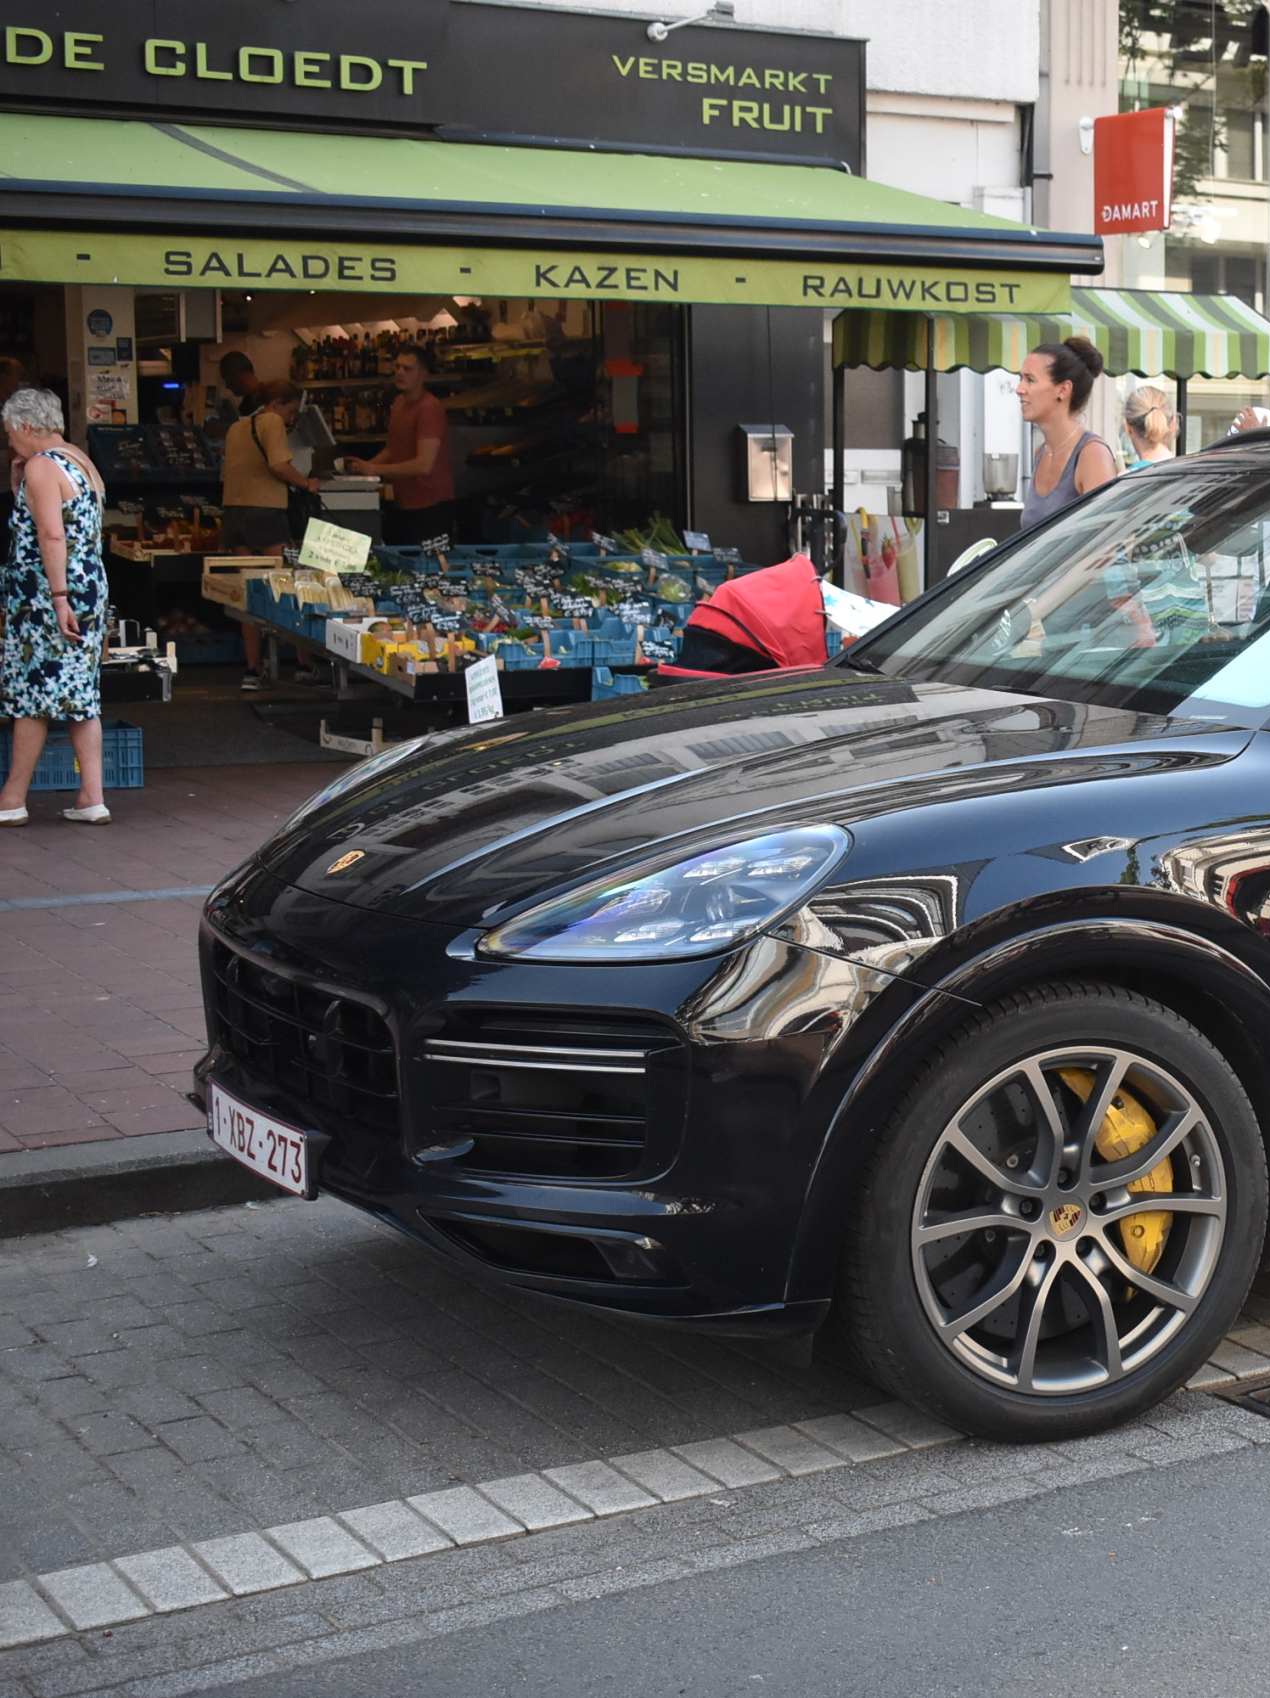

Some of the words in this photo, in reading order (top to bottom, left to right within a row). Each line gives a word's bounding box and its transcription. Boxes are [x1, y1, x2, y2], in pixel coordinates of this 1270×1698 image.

[6, 26, 104, 70] DE
[144, 38, 427, 95] CLOEDT
[612, 55, 832, 94] VERSMARKT
[703, 98, 832, 134] FRUIT
[1102, 200, 1159, 222] DAMART
[164, 251, 397, 282] SALADES
[535, 264, 679, 292] KAZEN
[803, 275, 1021, 304] RAUWKOST
[216, 1096, 302, 1184] 1-XBZ-273
